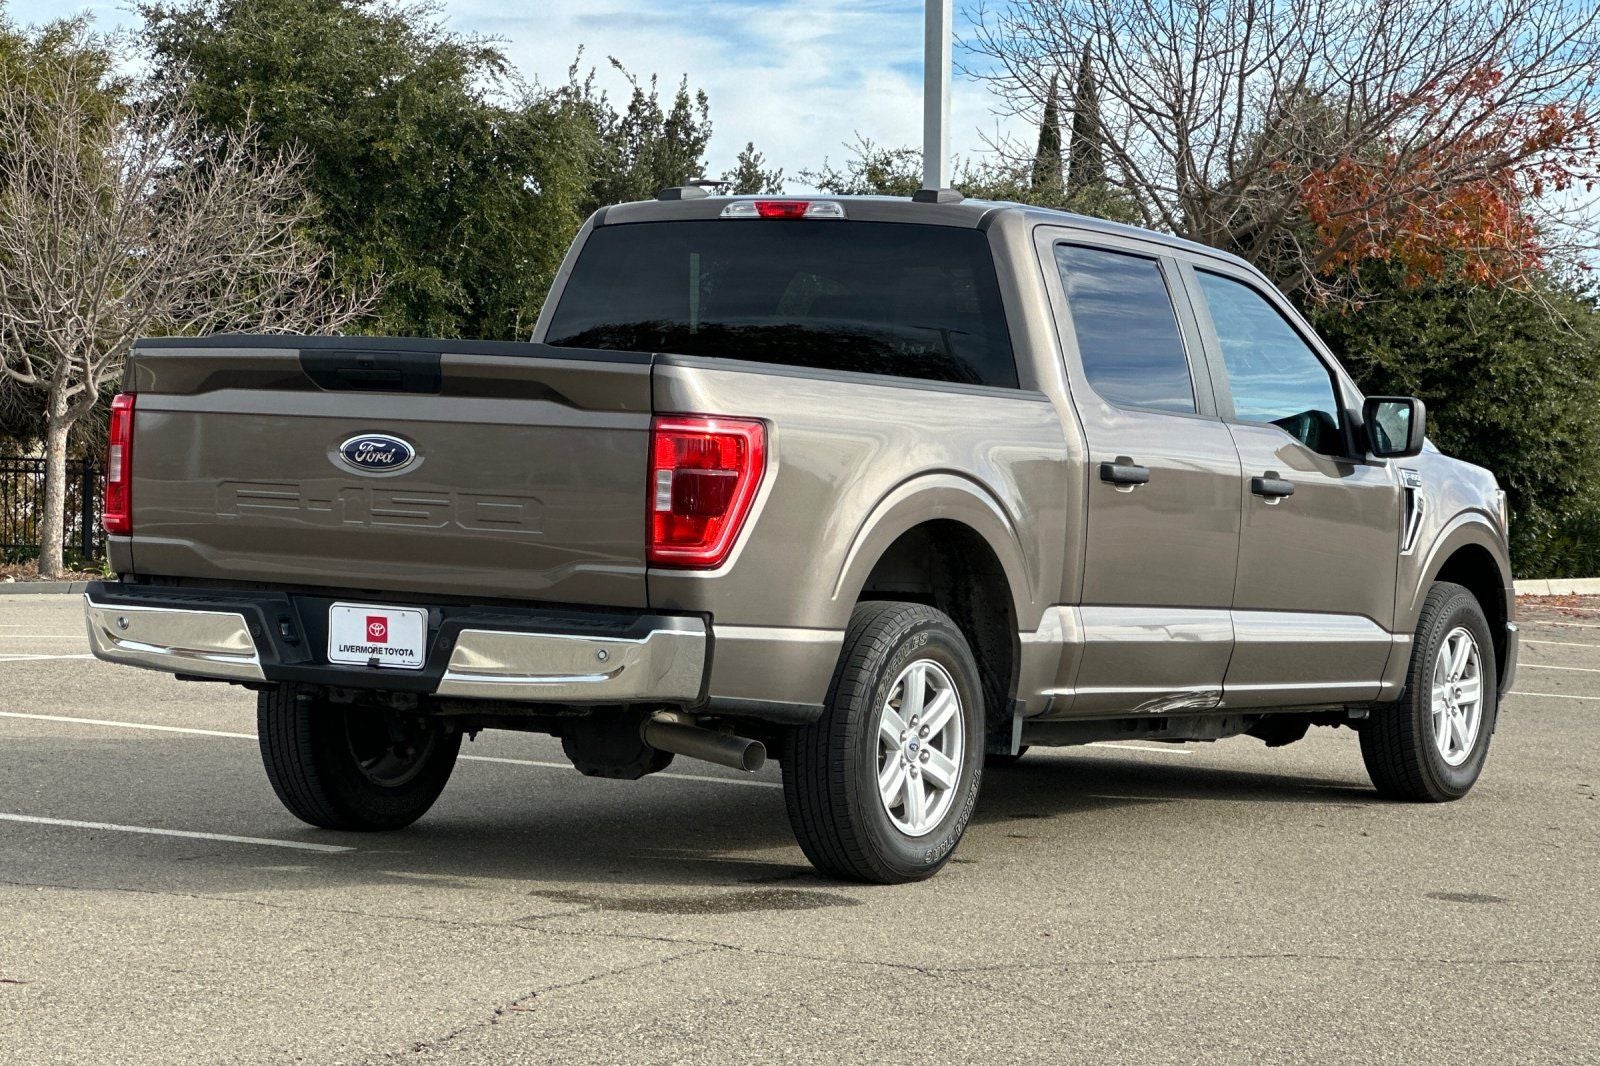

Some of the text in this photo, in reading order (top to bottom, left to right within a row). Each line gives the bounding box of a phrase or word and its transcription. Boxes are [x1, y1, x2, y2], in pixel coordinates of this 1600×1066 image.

[354, 441, 396, 464] Ford
[339, 644, 414, 657] LIVERMORE TOYOTA
[924, 768, 983, 865] TERRA TRAC
